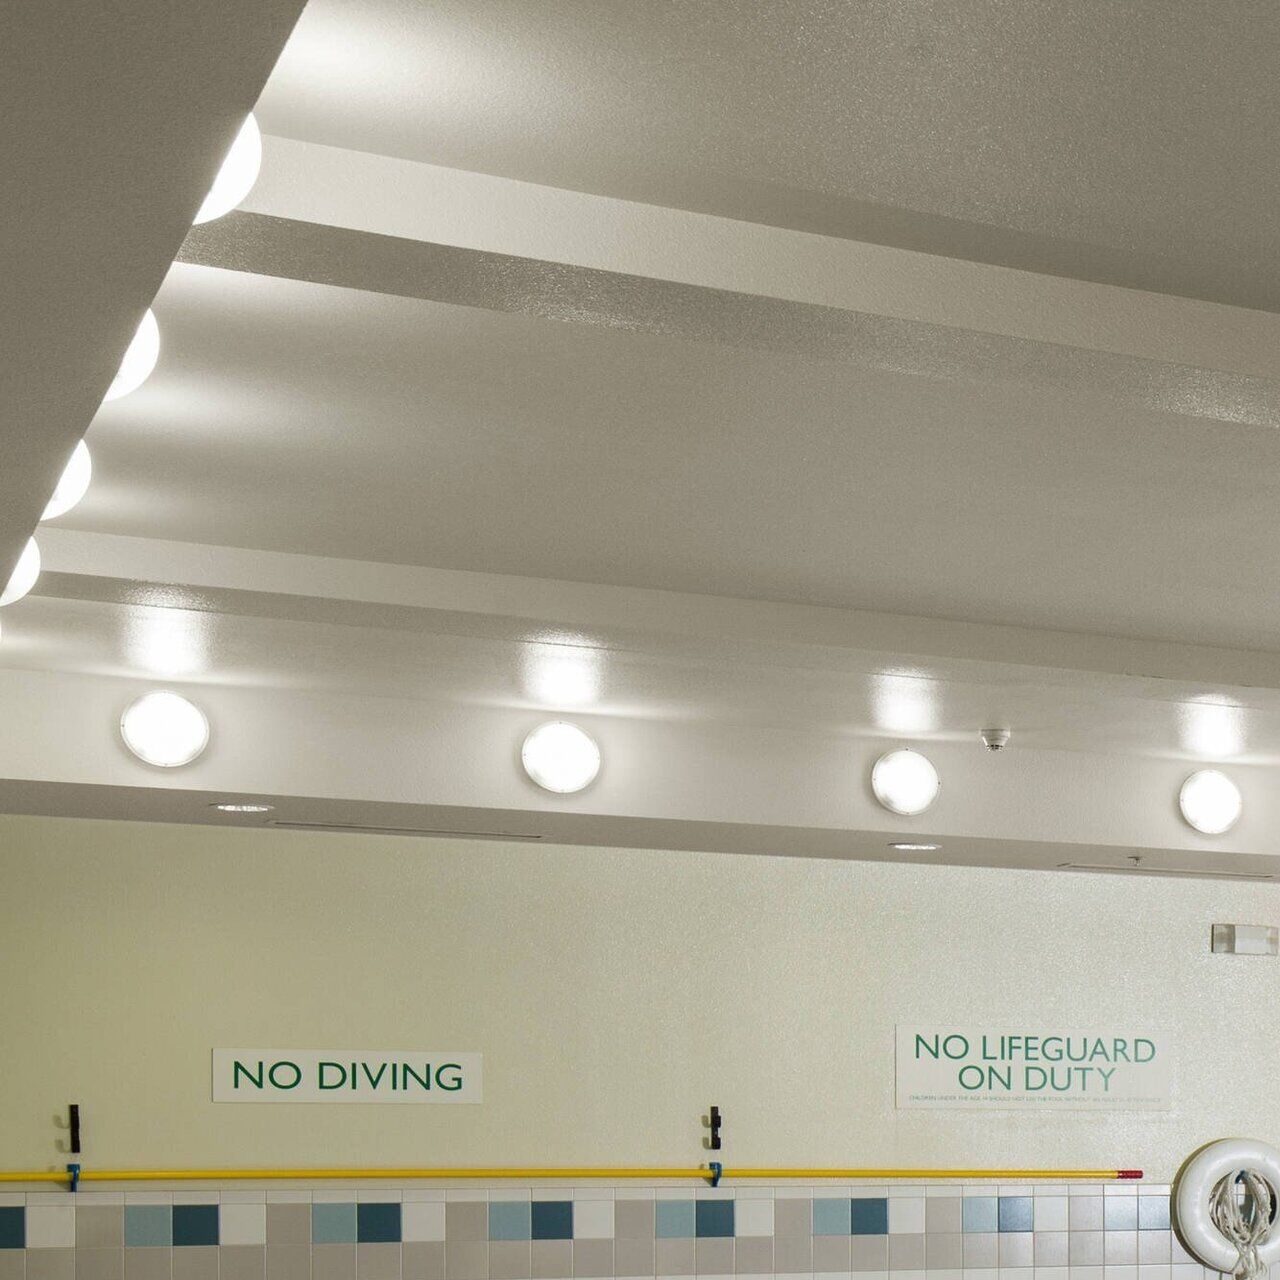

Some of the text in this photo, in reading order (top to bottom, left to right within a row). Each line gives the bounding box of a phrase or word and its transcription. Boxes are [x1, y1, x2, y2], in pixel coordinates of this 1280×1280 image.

[914, 1034, 1156, 1063] NO LIFEGUARD
[233, 1060, 463, 1092] NO DIVING
[958, 1065, 1117, 1092] ON DUTY
